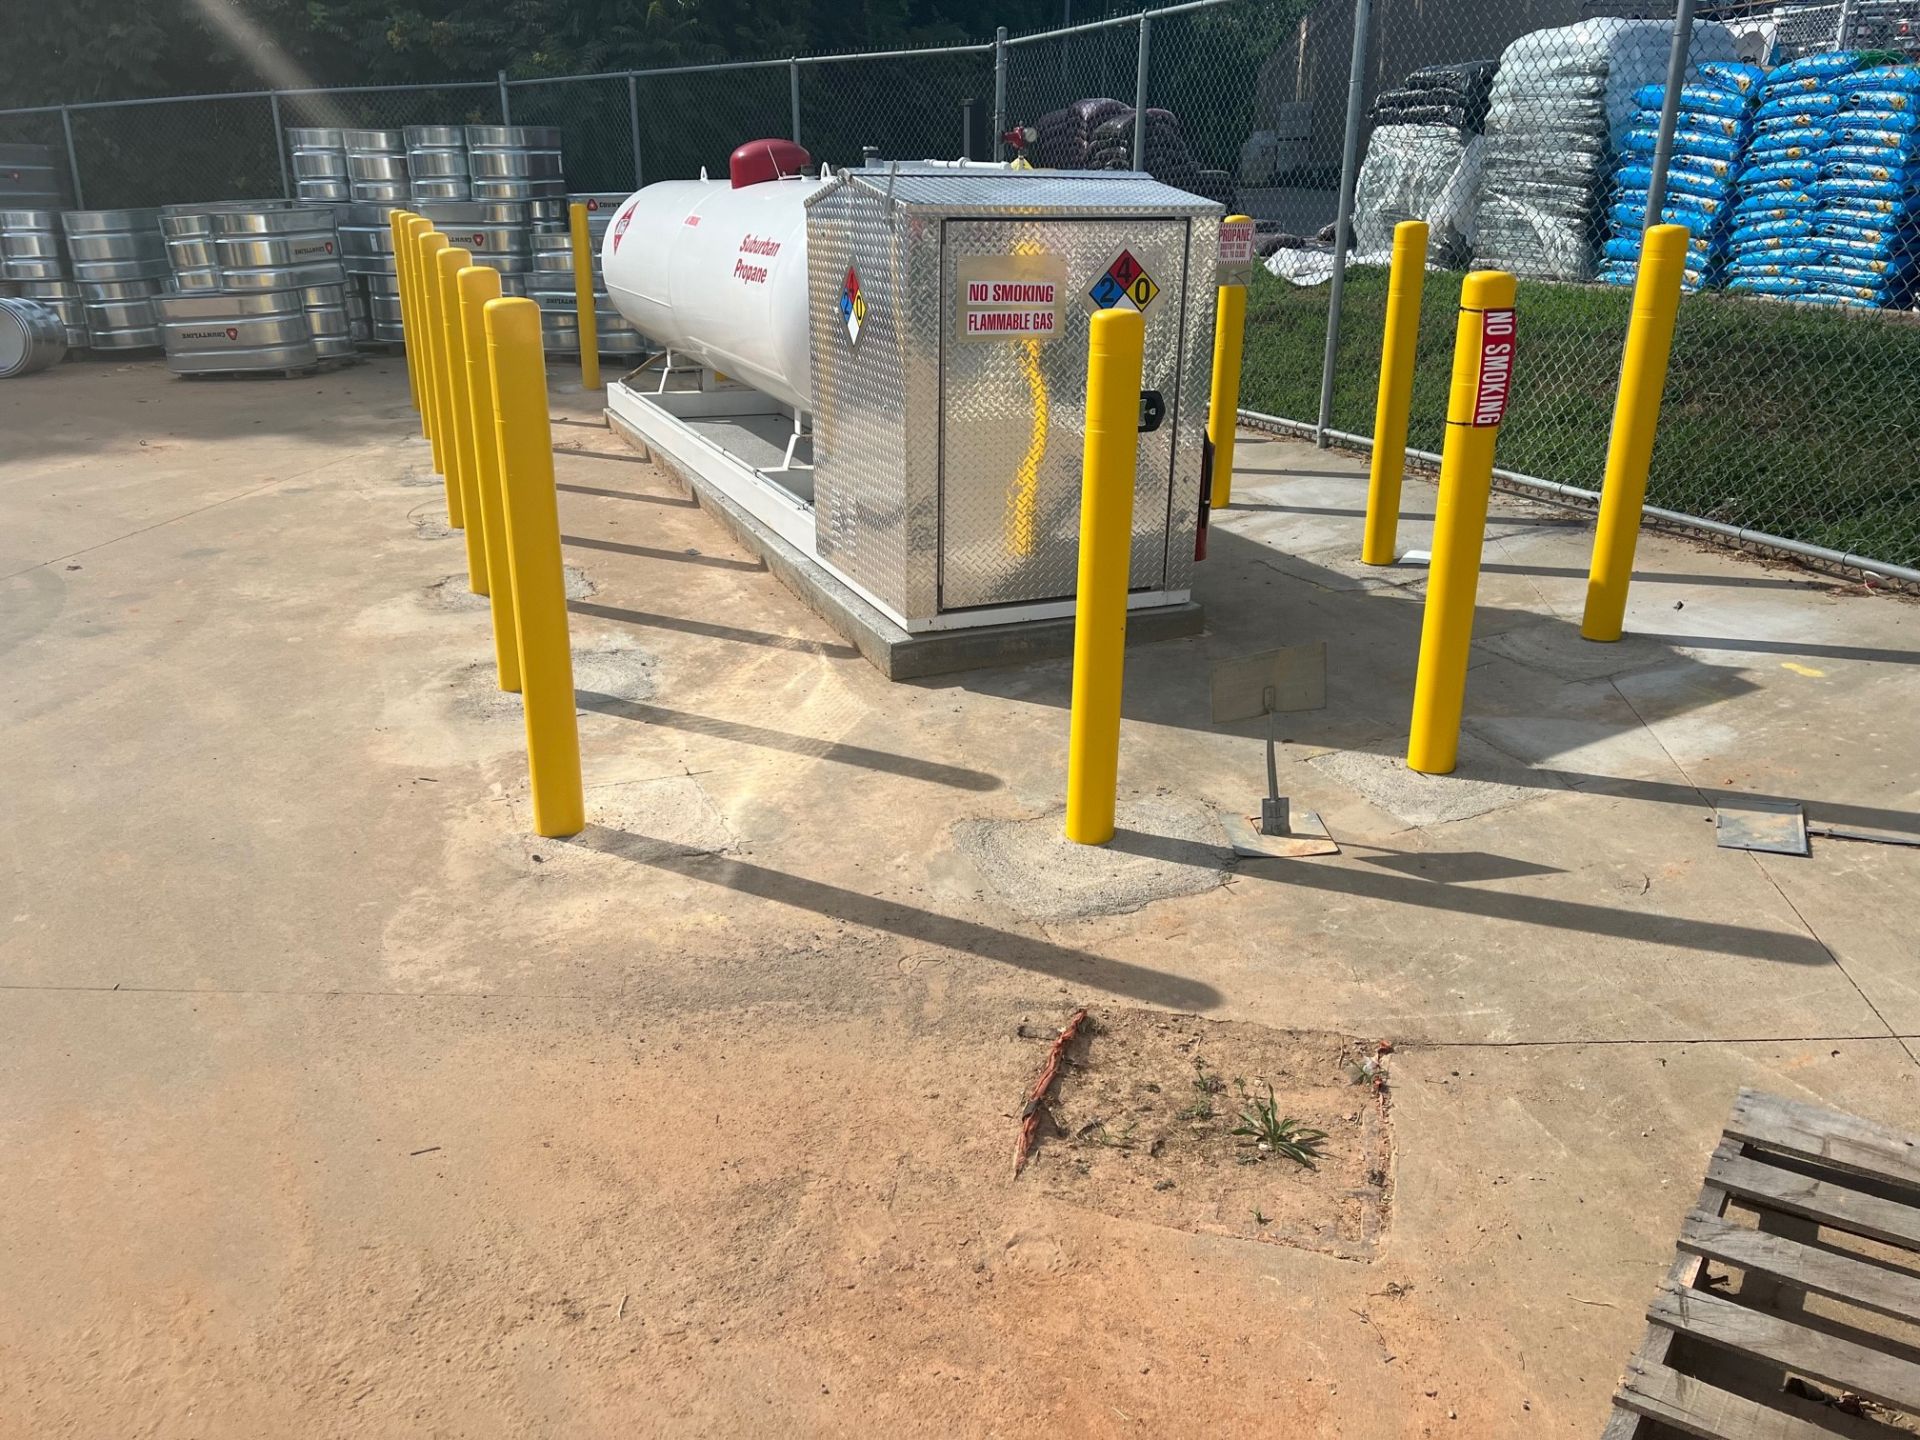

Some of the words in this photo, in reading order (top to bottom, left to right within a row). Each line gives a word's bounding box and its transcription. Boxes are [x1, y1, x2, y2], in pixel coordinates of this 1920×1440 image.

[739, 233, 781, 257] Suburban
[1218, 229, 1250, 242] PROPANE
[733, 258, 768, 285] Propane
[1117, 257, 1132, 283] 4
[969, 284, 988, 302] NO
[992, 284, 1054, 303] SMOKING
[1100, 277, 1115, 303] 2
[1135, 277, 1150, 304] 0
[968, 313, 1031, 331] FLAMMABLE
[1033, 312, 1053, 330] GAS
[1486, 311, 1513, 336] NO
[1476, 343, 1511, 424] SMOKING
